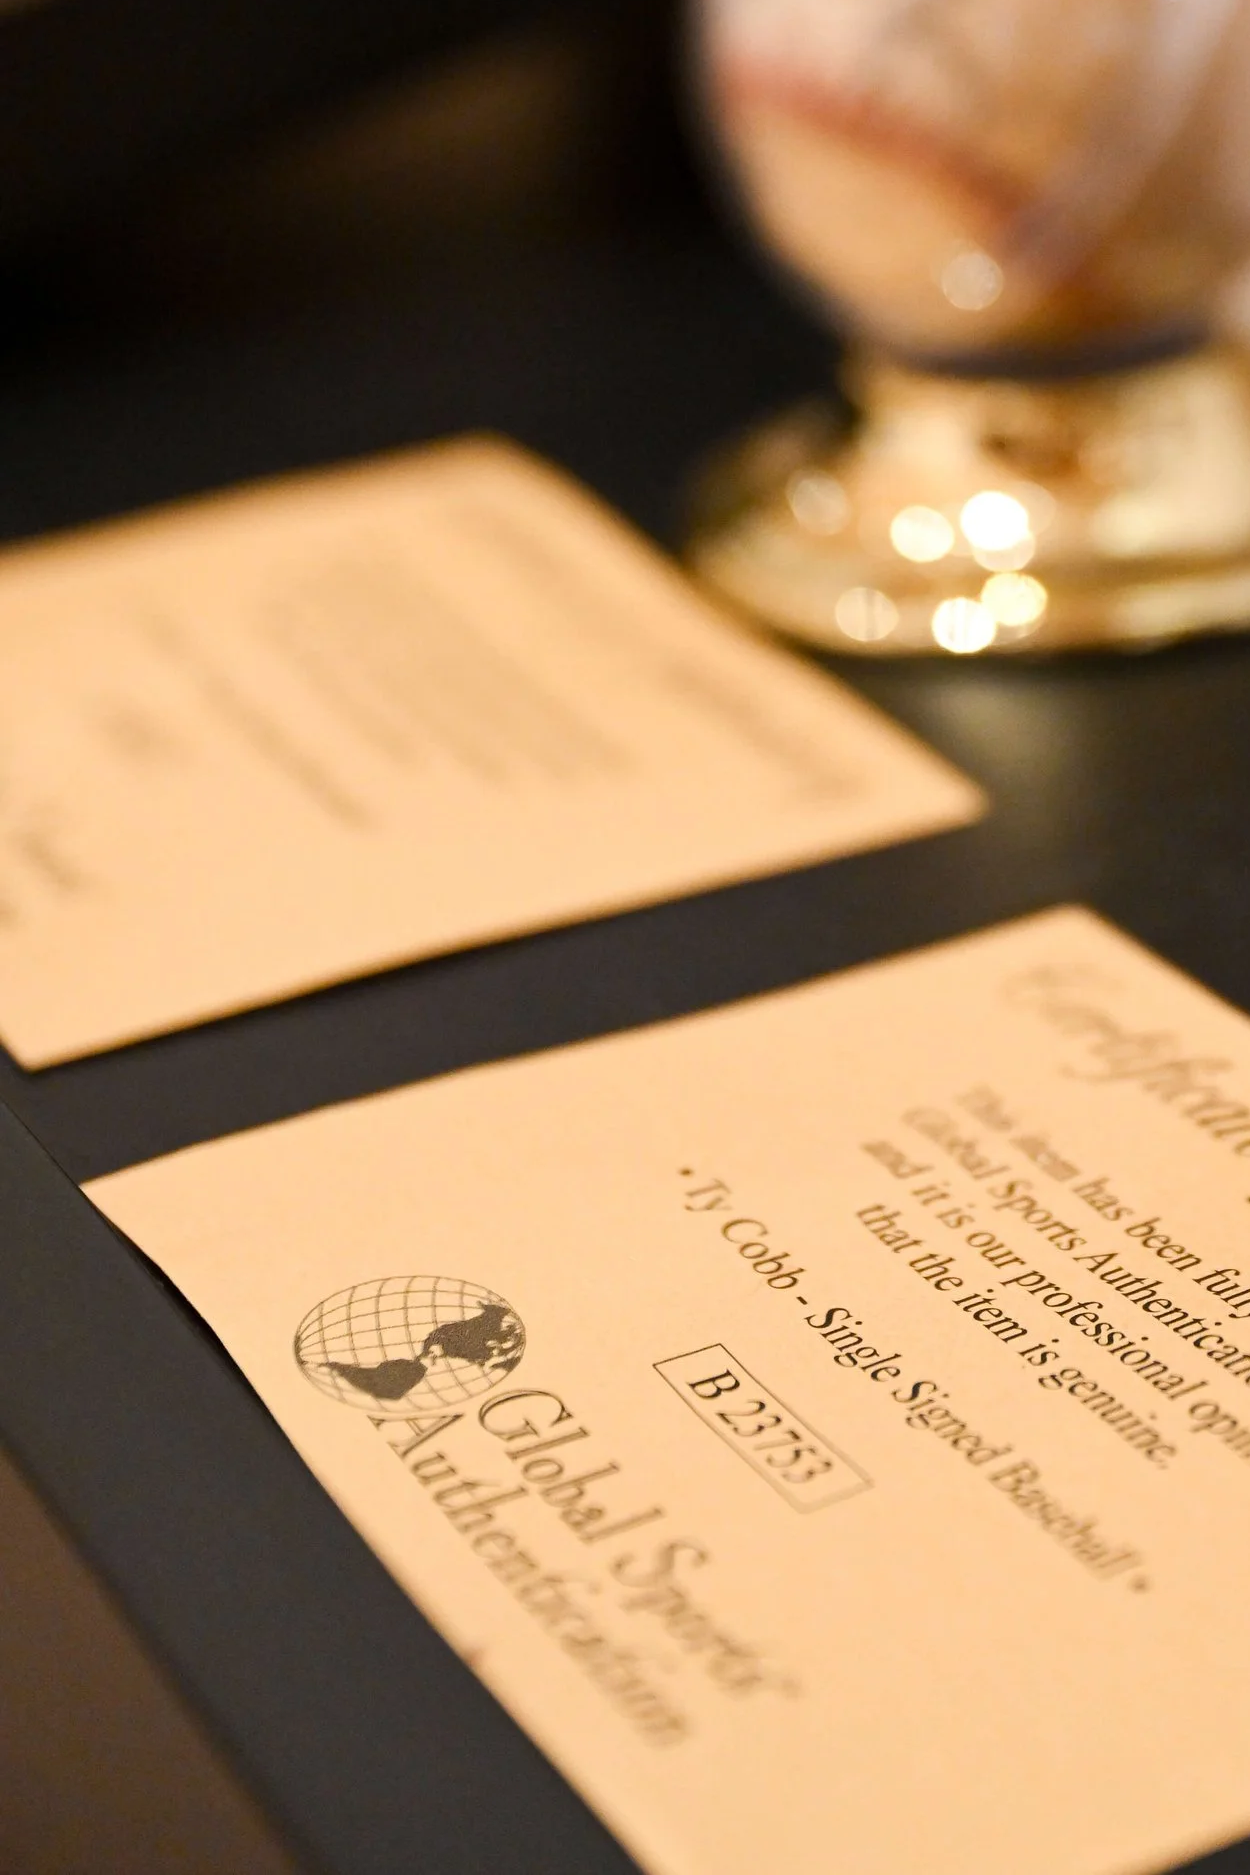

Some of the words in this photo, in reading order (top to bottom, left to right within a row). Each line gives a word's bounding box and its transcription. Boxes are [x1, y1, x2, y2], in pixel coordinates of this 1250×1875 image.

[856, 1202, 925, 1253] that
[986, 1179, 1087, 1252] Sports
[1071, 1177, 1134, 1222] has
[1124, 1217, 1202, 1272] been
[908, 1252, 964, 1292] the
[911, 1180, 951, 1207] it
[936, 1202, 975, 1229] is
[966, 1230, 1027, 1268] our
[1000, 1270, 1209, 1400] professional
[721, 1218, 806, 1290] Cobb
[804, 1307, 903, 1382] Single
[890, 1380, 1015, 1467] Signed
[953, 1288, 1030, 1347] item
[1018, 1338, 1060, 1367] is
[1038, 1366, 1178, 1470] genuine.
[478, 1388, 667, 1546] Global
